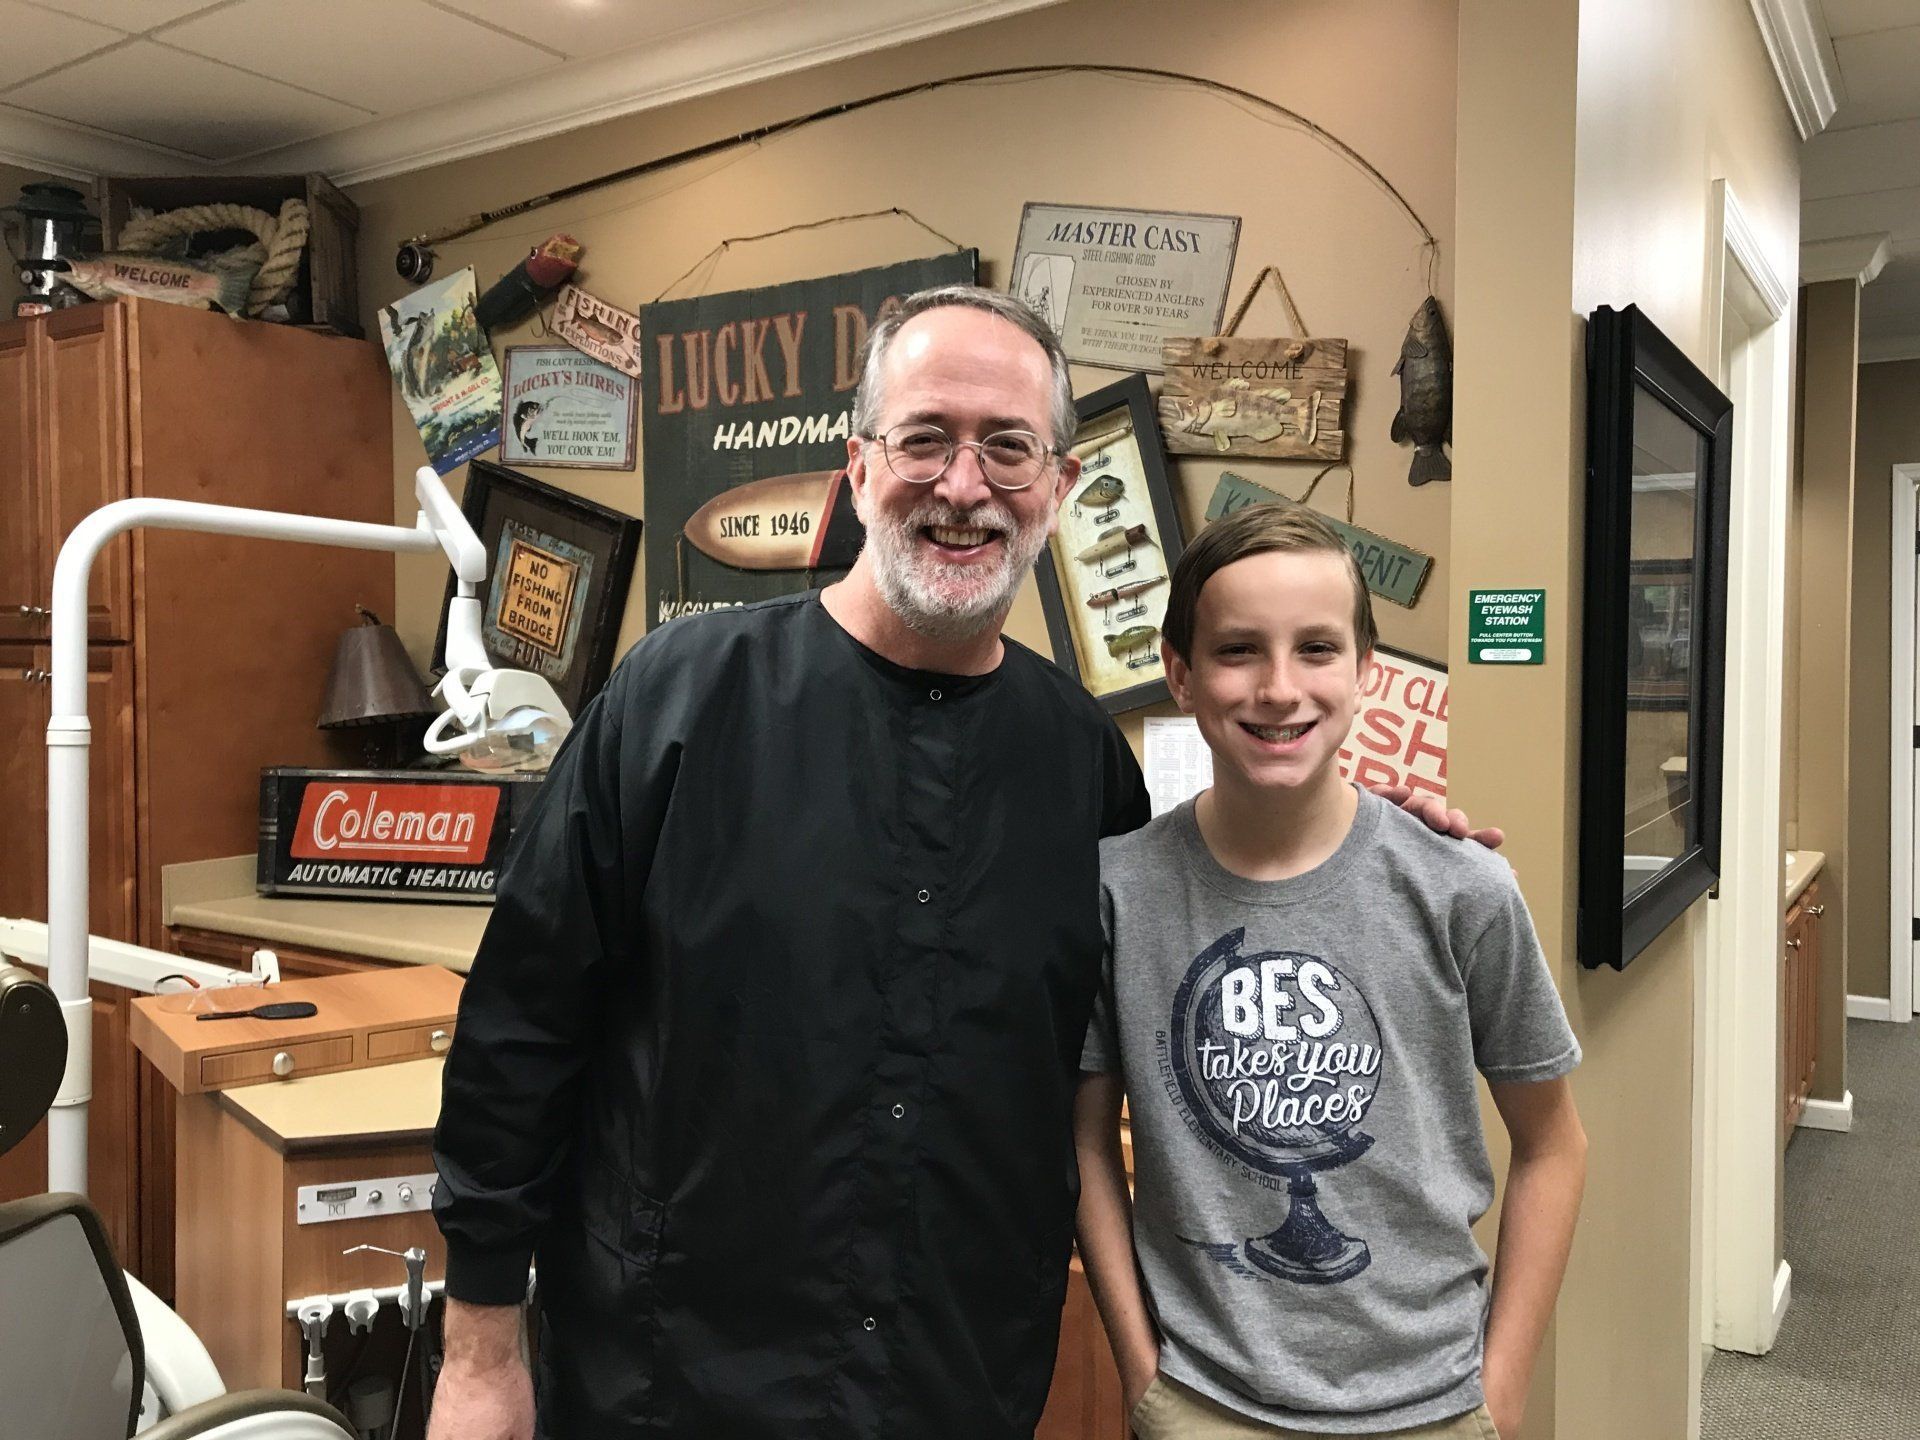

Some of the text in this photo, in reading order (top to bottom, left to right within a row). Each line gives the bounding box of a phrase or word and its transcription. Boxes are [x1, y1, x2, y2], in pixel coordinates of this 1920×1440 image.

[1046, 221, 1201, 254] MASTER CAST
[1082, 249, 1156, 267] STEEL FISHING RODS
[114, 263, 192, 288] WELCOME
[1116, 275, 1174, 289] CHOSEN BY
[1082, 285, 1205, 307] EXPERIENCED ANGLERS
[1092, 300, 1189, 319] FOR OVER 50 YEARS
[565, 327, 623, 365] EXPEDITIONS
[1129, 343, 1161, 354] JUDGE
[536, 358, 551, 367] FISH
[656, 310, 808, 416] LUCKY
[1191, 360, 1305, 381] WELCOME
[512, 370, 625, 400] LUCKY'S LURES
[543, 430, 570, 441] WE'LL
[572, 430, 601, 442] HOOK
[713, 410, 851, 451] HANDMA
[547, 444, 566, 455] YOU
[568, 445, 593, 456] COOK
[720, 511, 811, 538] SINCE 1946
[529, 561, 548, 580] NO
[512, 573, 562, 605] FISHING
[1474, 593, 1541, 604] EMERGENCY
[515, 594, 551, 620] FROM
[1481, 605, 1533, 615] EYEWASH
[508, 609, 554, 641] BRIDGE
[1485, 616, 1529, 626] STATION
[1403, 676, 1448, 722] CLE
[1355, 708, 1448, 779] SH
[313, 790, 475, 851] Coleman
[288, 864, 495, 890] AUTOMATIC HEATING
[1221, 958, 1344, 1044] BES
[1197, 1037, 1382, 1092] takes you
[1155, 1030, 1284, 1192] BATTLEFIELD ELEMENTARY SCHOOL
[1227, 1079, 1372, 1136] Places
